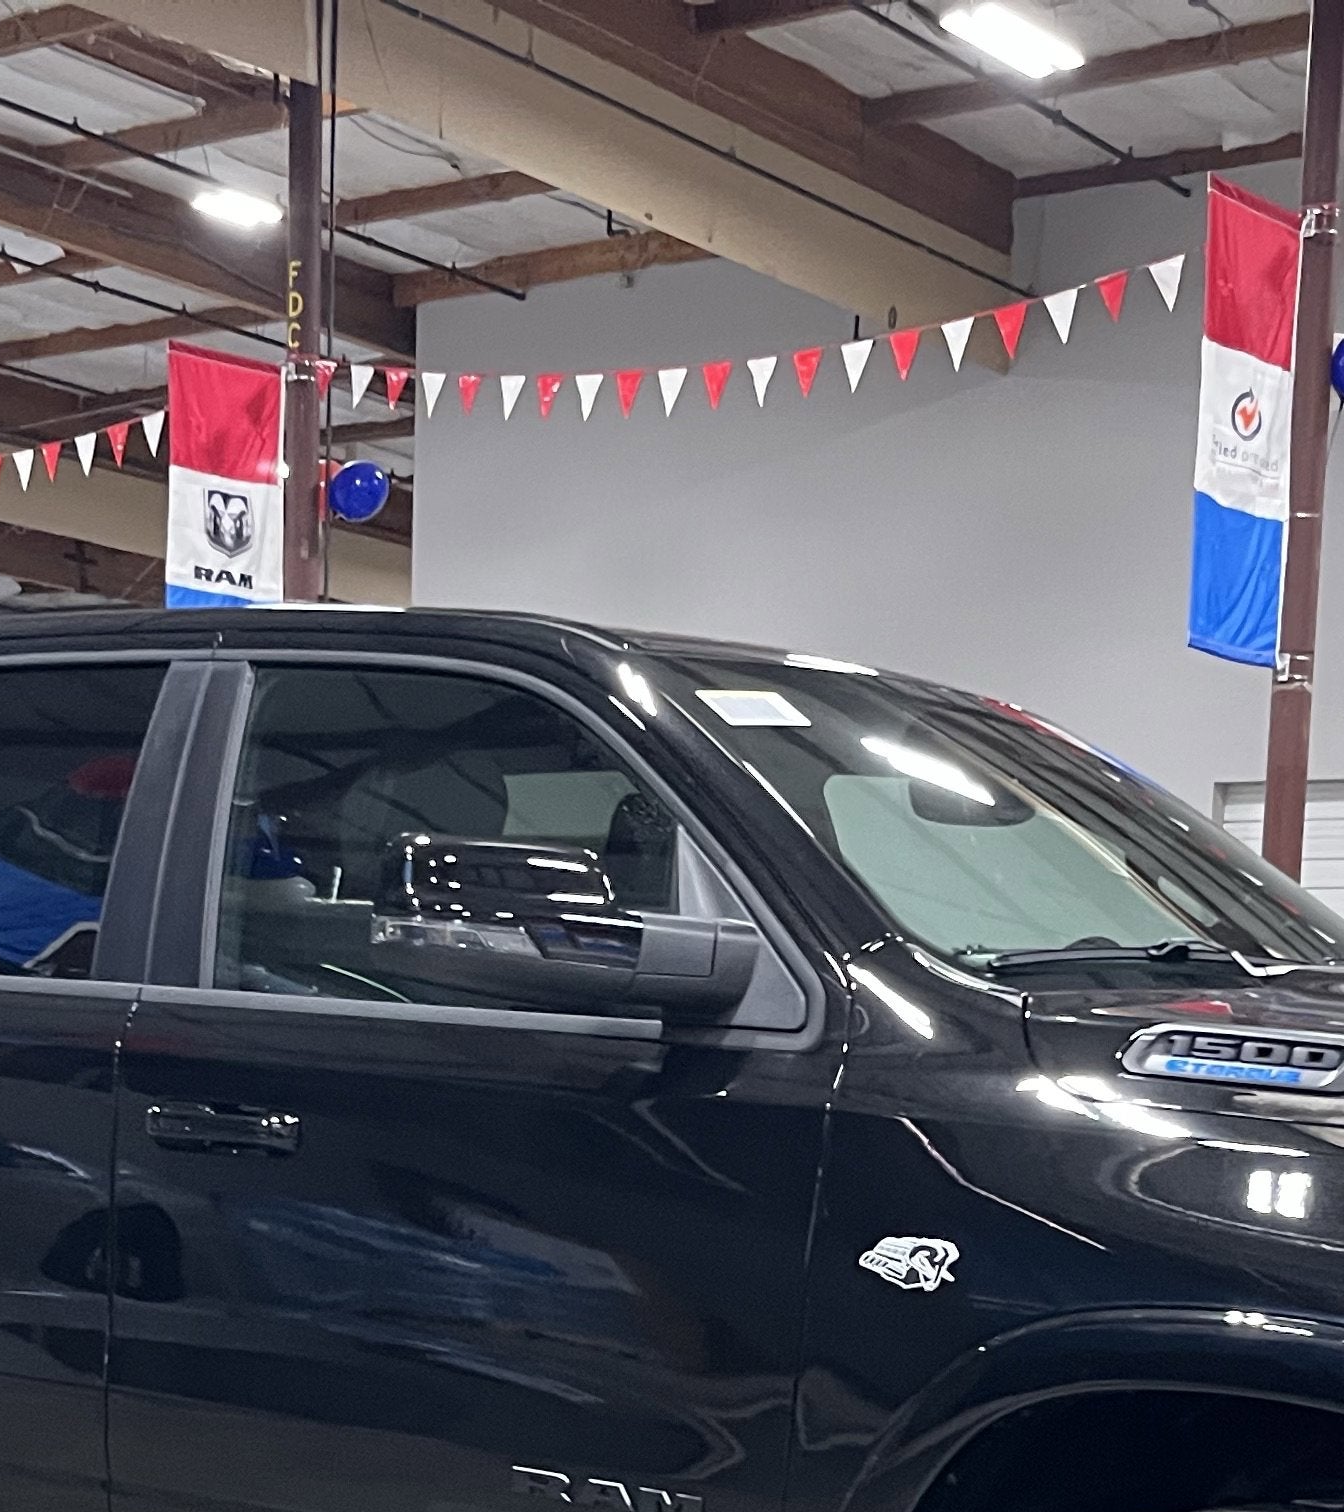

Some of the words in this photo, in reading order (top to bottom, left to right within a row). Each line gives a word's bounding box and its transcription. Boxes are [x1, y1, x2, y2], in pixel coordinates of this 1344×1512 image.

[288, 260, 303, 348] FDC
[193, 565, 254, 590] RAM
[1169, 1033, 1342, 1069] 1500
